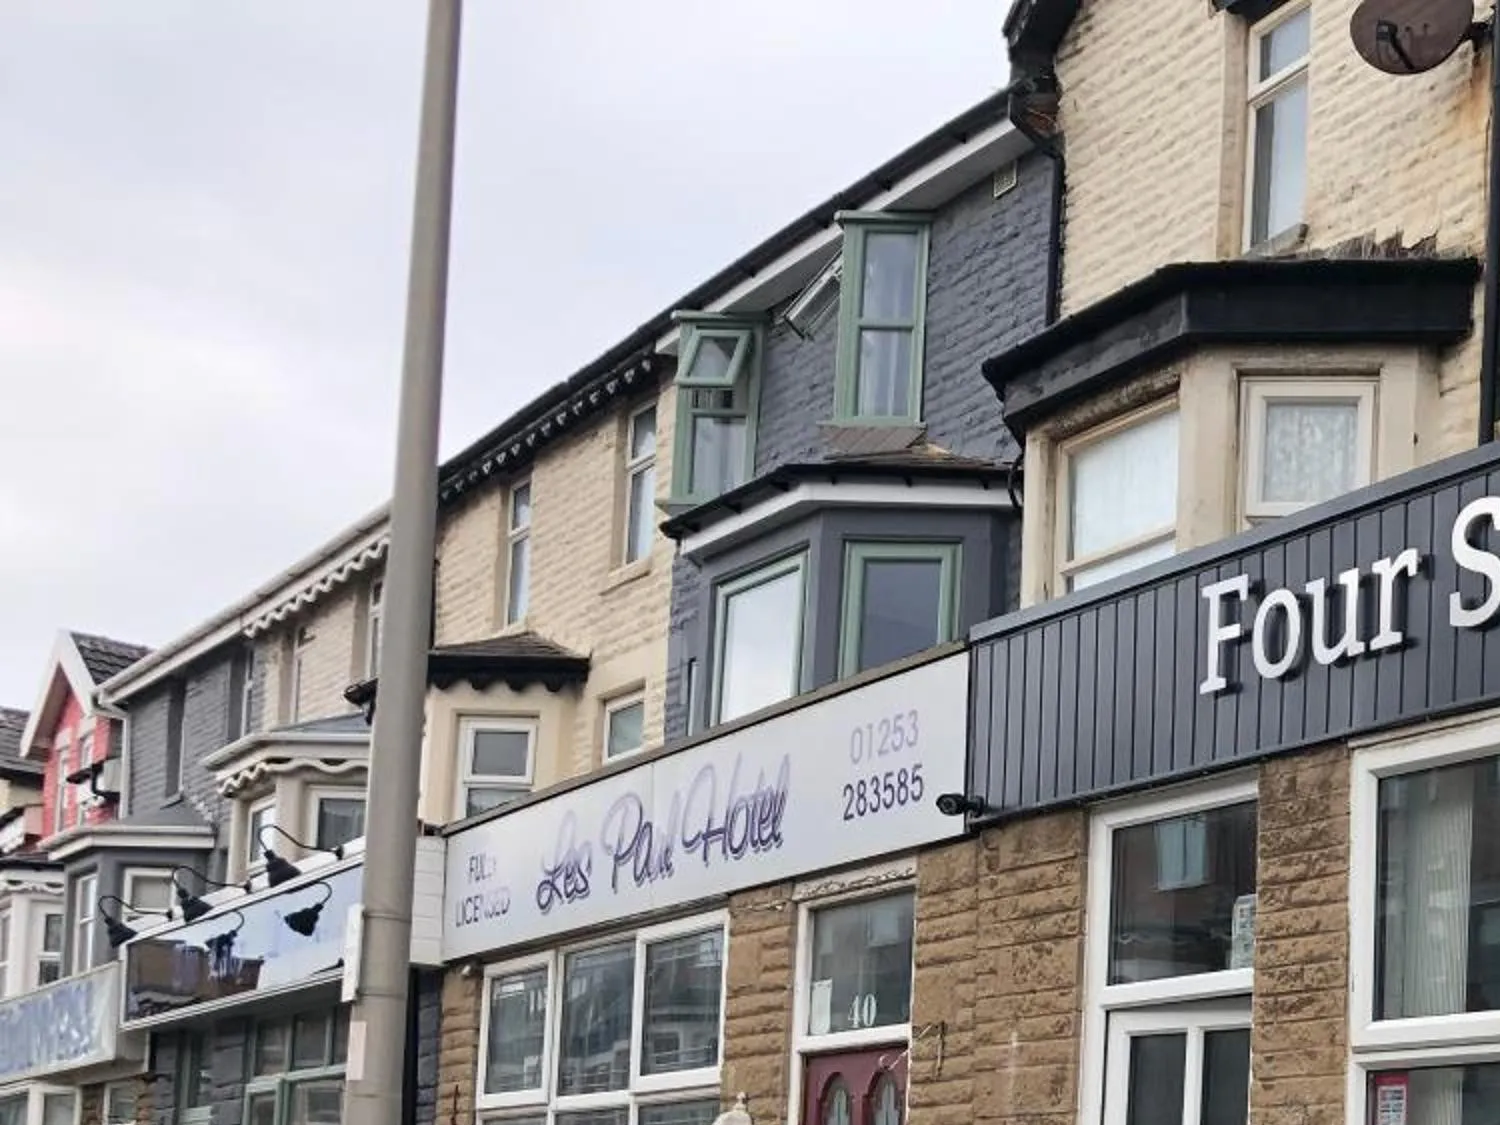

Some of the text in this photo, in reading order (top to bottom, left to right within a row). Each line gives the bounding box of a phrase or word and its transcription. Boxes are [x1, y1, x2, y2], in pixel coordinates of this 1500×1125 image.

[1199, 548, 1421, 695] Four
[850, 709, 919, 764] 01253
[843, 763, 924, 821] 283585
[536, 810, 592, 915] Les
[682, 752, 791, 868] Hotel
[847, 992, 877, 1029] 40
